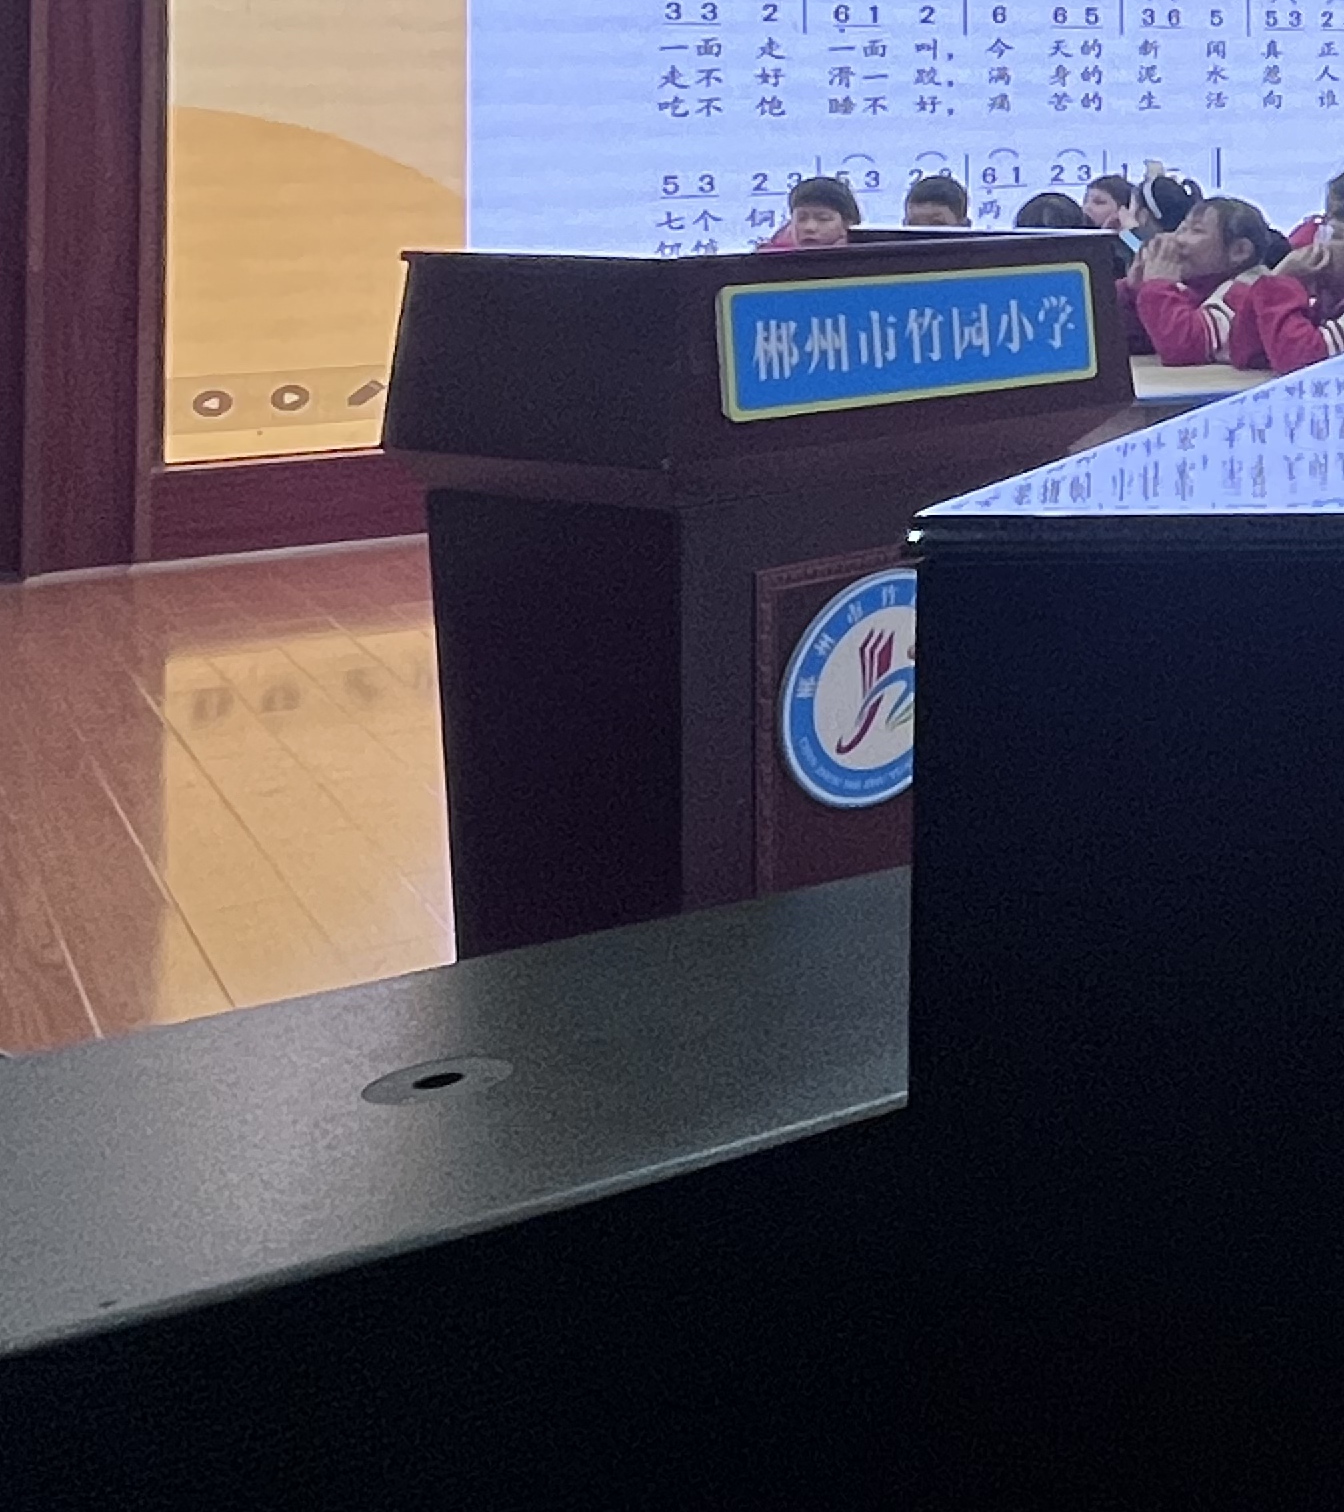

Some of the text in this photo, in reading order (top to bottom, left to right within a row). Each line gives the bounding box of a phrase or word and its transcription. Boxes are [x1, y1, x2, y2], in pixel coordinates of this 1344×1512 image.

[753, 295, 1076, 382] 郴州市竹园小学
